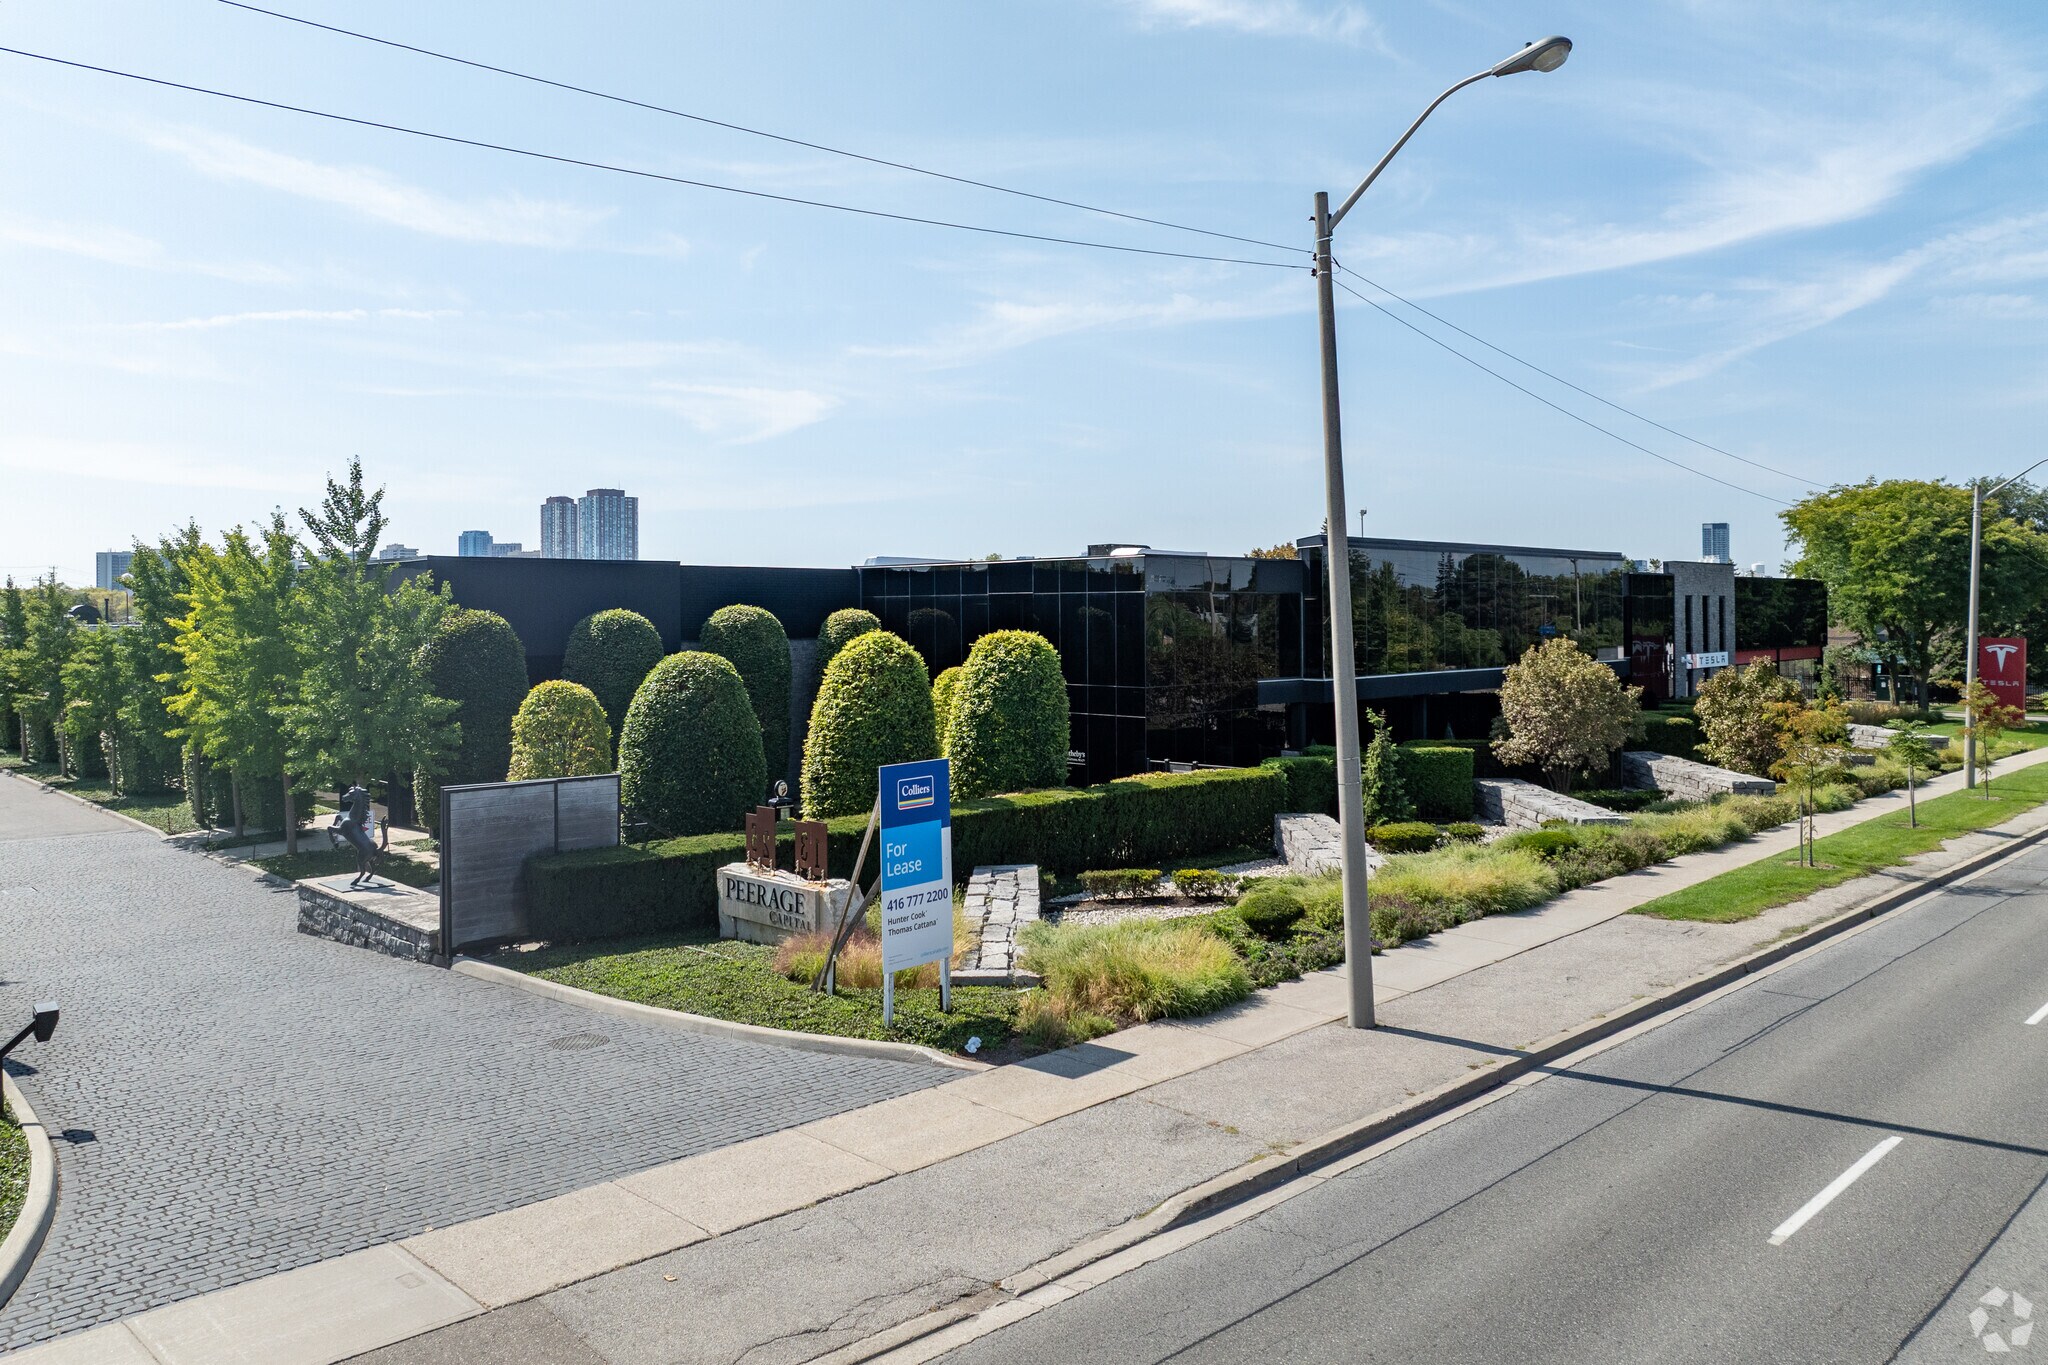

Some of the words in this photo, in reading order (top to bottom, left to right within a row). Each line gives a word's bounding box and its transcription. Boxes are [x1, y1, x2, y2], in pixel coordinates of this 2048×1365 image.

[1699, 655, 1726, 665] TESLA
[901, 784, 931, 797] Colliers
[886, 842, 908, 859] For
[887, 859, 922, 877] Lease
[726, 878, 804, 914] PEERAGE
[887, 897, 905, 911] 416
[906, 893, 924, 908] 777
[926, 887, 949, 903] 2200
[769, 910, 812, 931] CAPITAL
[887, 916, 910, 926] Hunter
[888, 926, 913, 936] Thomas
